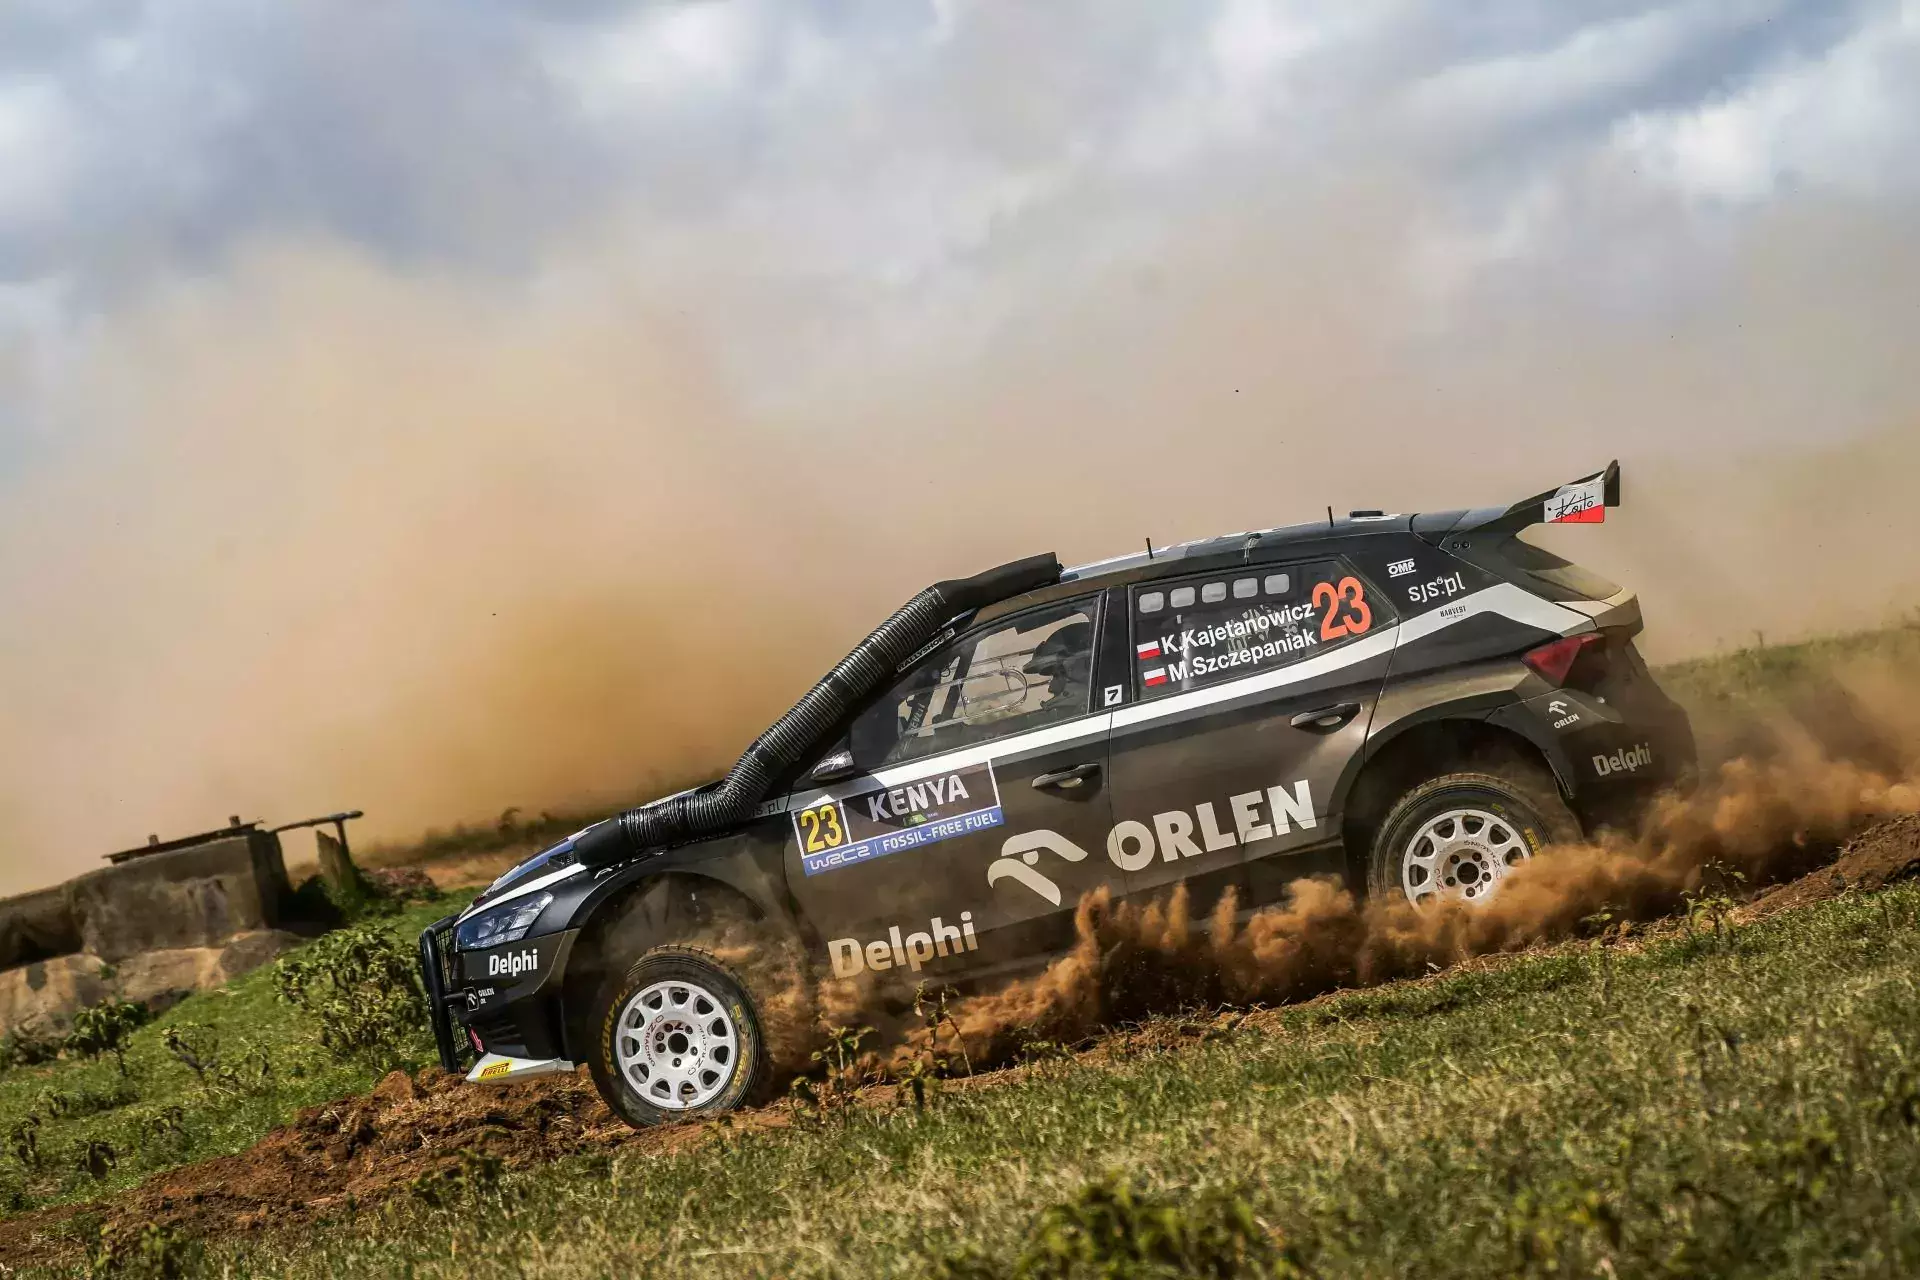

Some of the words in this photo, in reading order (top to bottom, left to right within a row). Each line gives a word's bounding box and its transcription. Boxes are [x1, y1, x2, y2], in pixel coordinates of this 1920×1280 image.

[1388, 560, 1416, 575] OMP
[1311, 576, 1372, 642] 23
[1107, 688, 1120, 702] 7
[1553, 713, 1580, 729] ORLEN
[1592, 742, 1653, 777] Delphi
[867, 774, 970, 823] KENYA
[800, 804, 843, 853] 23
[882, 822, 963, 851] FOSSIL-FREE
[966, 812, 998, 830] FUEL
[1107, 779, 1317, 872] ORLEN
[810, 846, 871, 870] WRC2
[827, 911, 978, 980] Delphi
[489, 949, 538, 977] Delphi
[478, 987, 495, 998] ORLEN
[481, 1062, 511, 1078] PIRELLI
